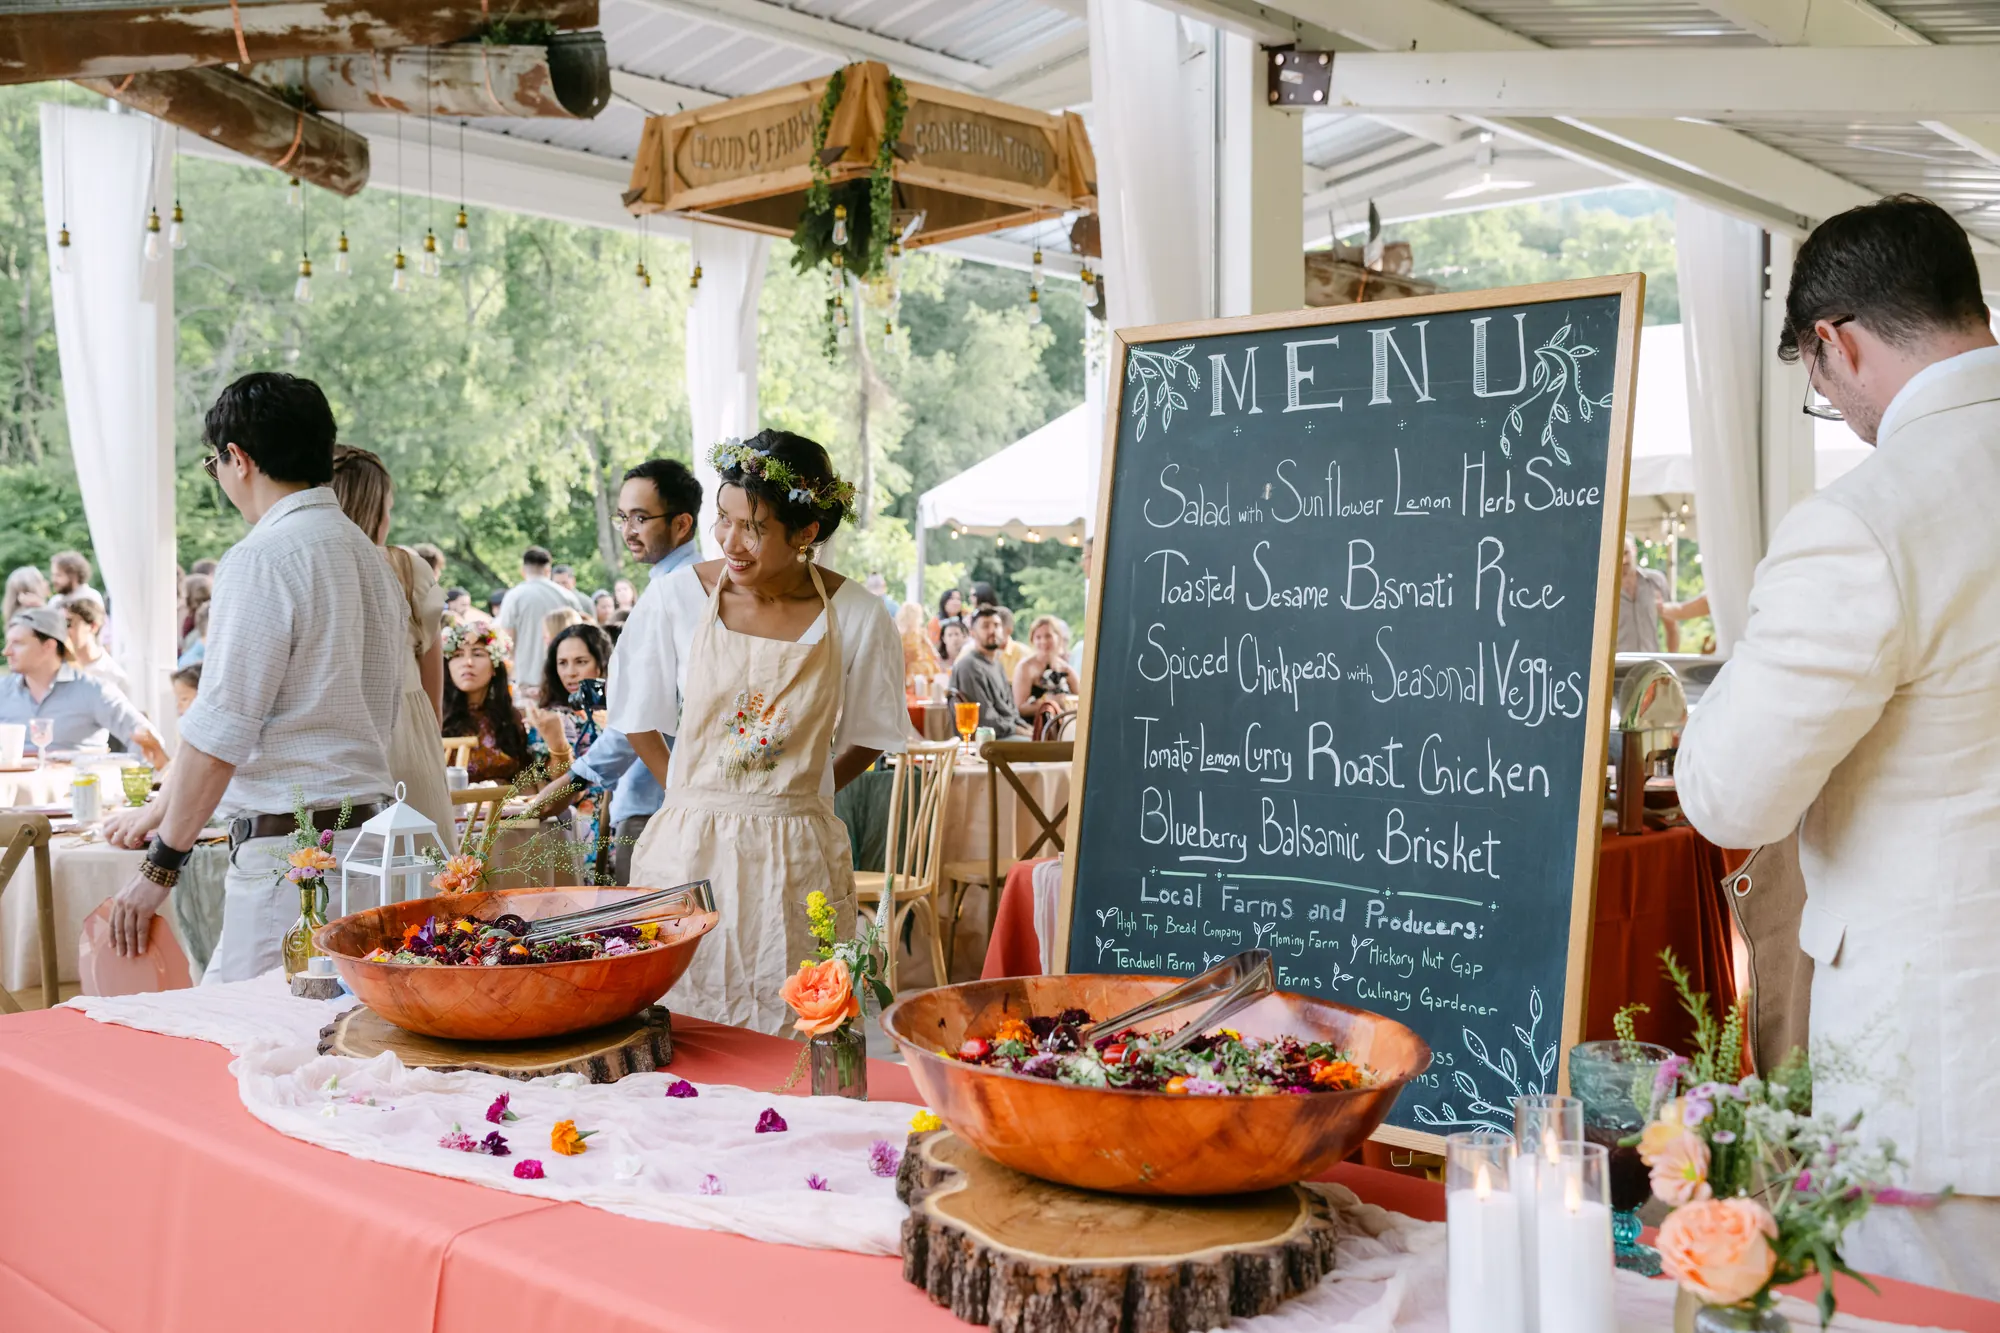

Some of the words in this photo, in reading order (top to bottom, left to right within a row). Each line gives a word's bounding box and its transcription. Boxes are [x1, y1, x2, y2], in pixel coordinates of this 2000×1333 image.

[748, 129, 762, 172] 9
[1207, 312, 1528, 417] MENU
[1143, 463, 1231, 529] Salad
[1238, 503, 1263, 525] with
[1271, 459, 1384, 523] Sunflower
[1393, 447, 1452, 516] Lemon
[1461, 450, 1516, 518] Herb
[1524, 456, 1600, 512] Sauce
[1143, 548, 1237, 608] Toasted
[1245, 540, 1329, 611] Sesame
[1340, 538, 1454, 612] Basmati
[1475, 536, 1566, 628] Rice
[1138, 623, 1229, 707] Spiced
[1237, 632, 1342, 713] Chickpeas
[1346, 666, 1374, 685] with
[1371, 625, 1486, 706] Seasonal
[1492, 638, 1584, 728] Veggies
[1244, 722, 1293, 784] Curry
[1307, 720, 1406, 788] Roast
[1418, 732, 1551, 798] Chicken
[1139, 785, 1248, 863] Blueberry
[1258, 796, 1366, 861] Balsamic
[1376, 807, 1502, 880] Brisket
[1116, 911, 1137, 937] High
[1141, 913, 1159, 938] Top
[1165, 915, 1197, 935] Bread
[1203, 920, 1242, 946] Company
[1139, 876, 1201, 909] Local
[1220, 884, 1295, 922] Farms
[1308, 898, 1348, 923] and
[1363, 898, 1486, 940] Producers:
[1111, 948, 1162, 970] Tendwell
[1167, 952, 1195, 972] Farm
[1308, 930, 1339, 950] Farm
[1369, 944, 1415, 979] Hickory
[1421, 946, 1446, 971] Nut
[1450, 952, 1484, 981] Gap
[1277, 966, 1323, 990] Farms
[1356, 977, 1412, 1012] Culinary
[1419, 986, 1499, 1017] Gardener
